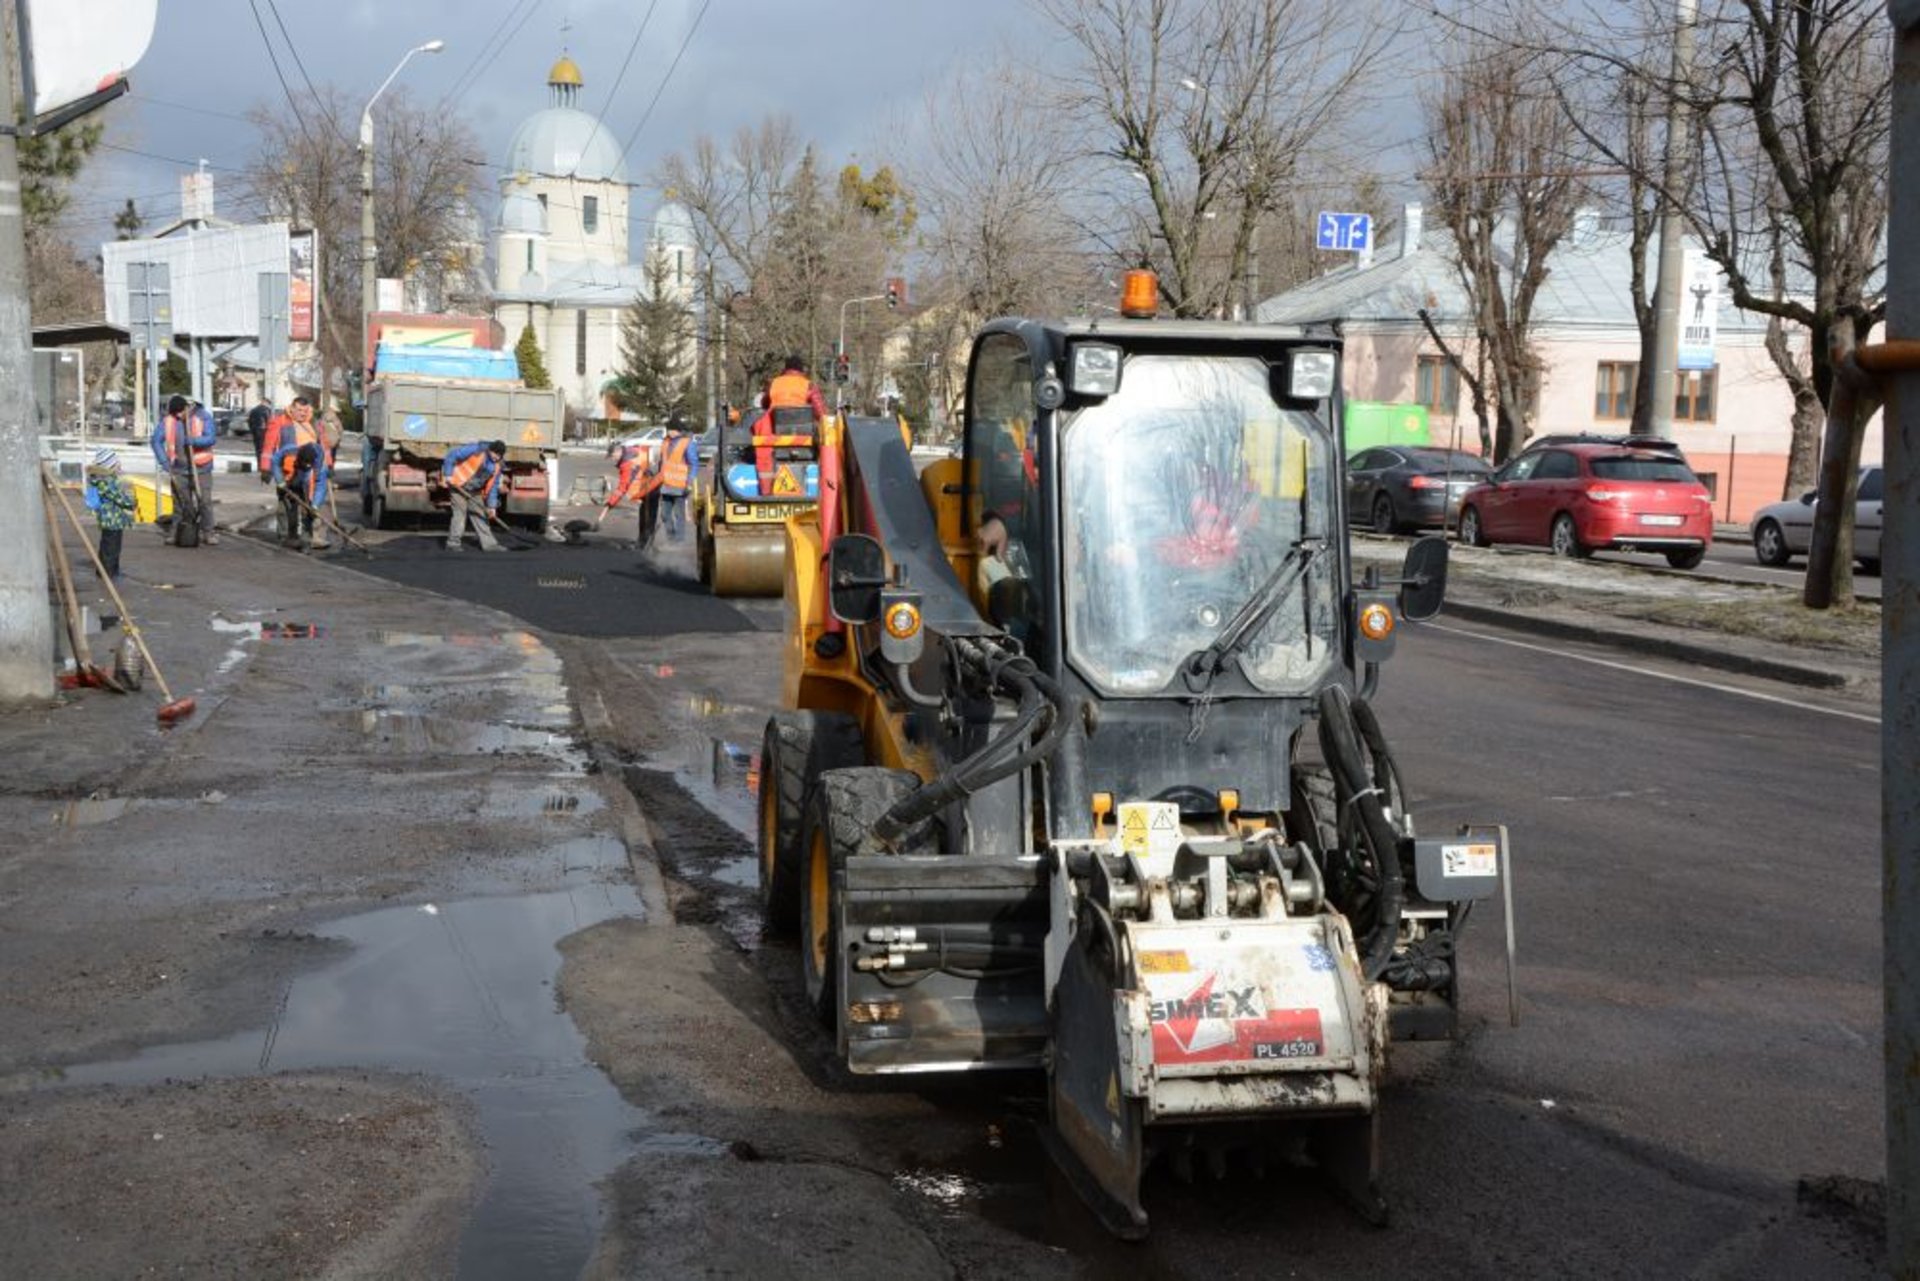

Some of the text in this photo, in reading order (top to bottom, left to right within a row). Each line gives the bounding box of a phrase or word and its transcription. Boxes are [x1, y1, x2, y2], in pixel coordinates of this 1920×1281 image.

[1150, 986, 1260, 1021] SIMEX
[1256, 1042, 1316, 1058] PL 4520
